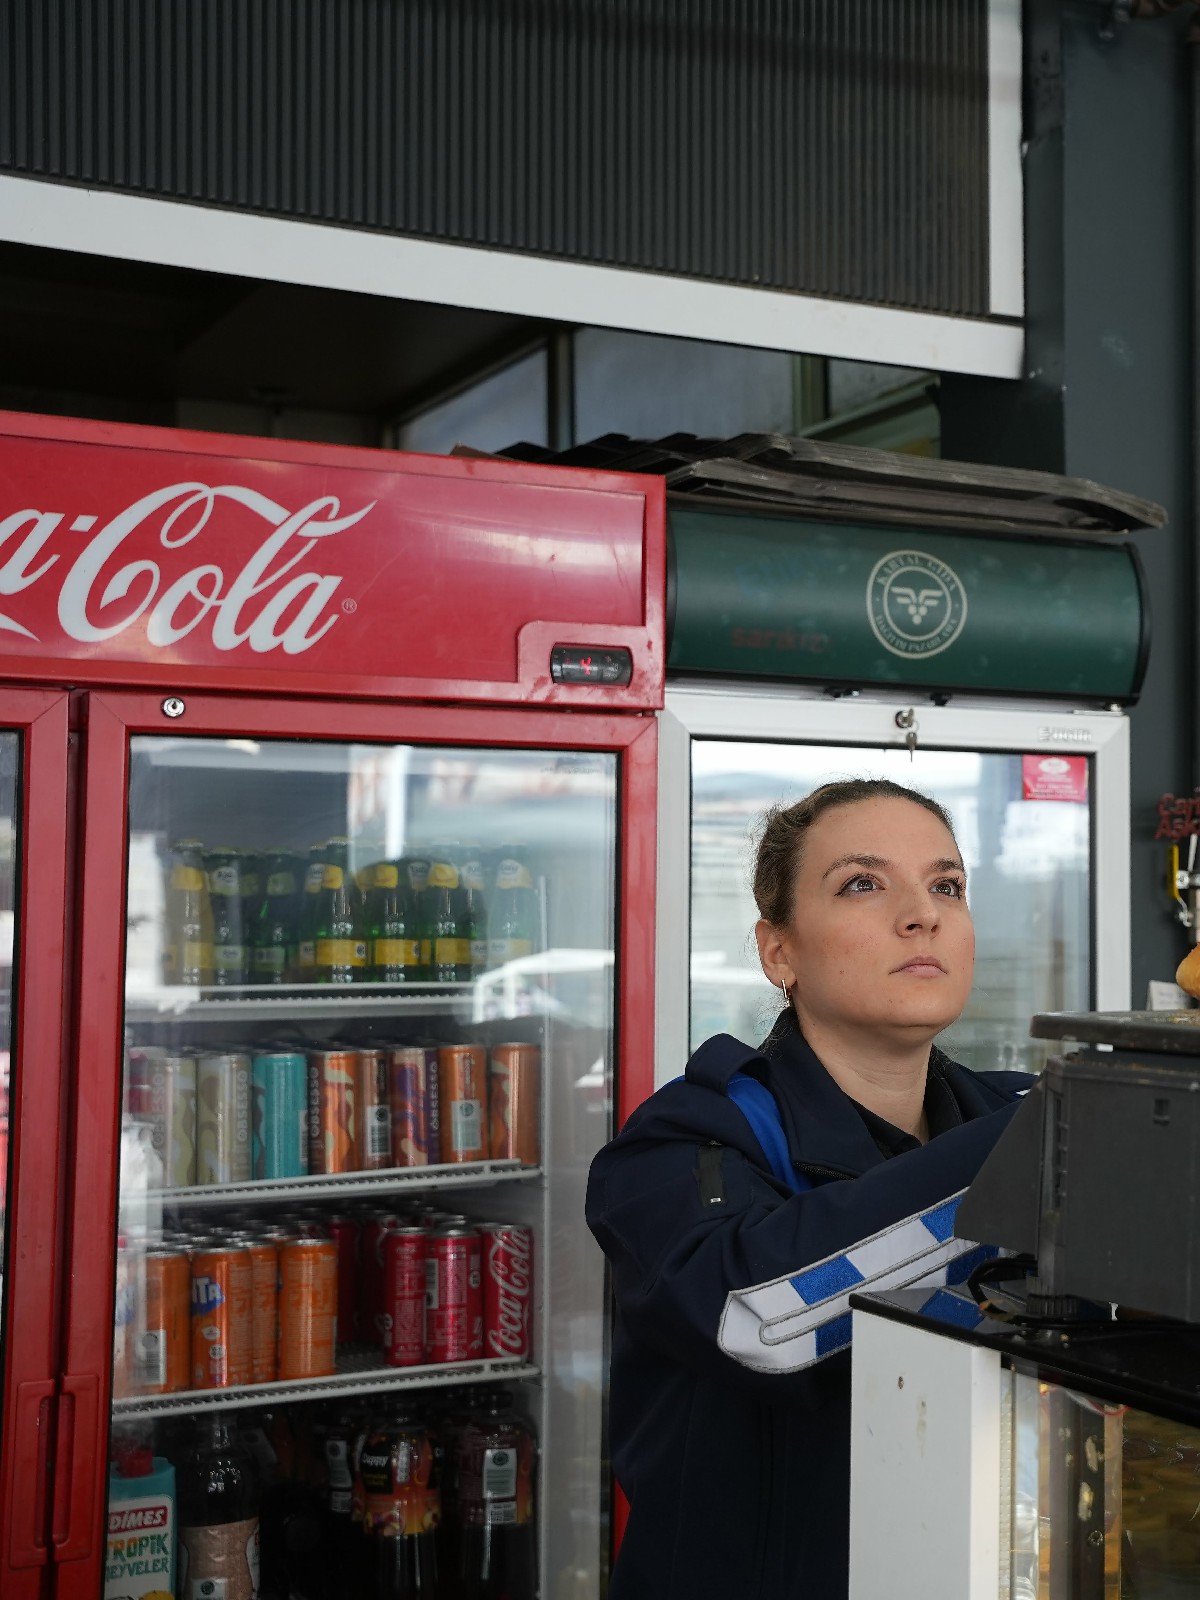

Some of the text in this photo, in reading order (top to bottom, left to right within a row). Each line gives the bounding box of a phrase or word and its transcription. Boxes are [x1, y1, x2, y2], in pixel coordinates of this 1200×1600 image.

[237, 1070, 248, 1142] OBSESSO
[309, 1066, 320, 1138] OBSESSO
[430, 1061, 439, 1131] OBSESSO
